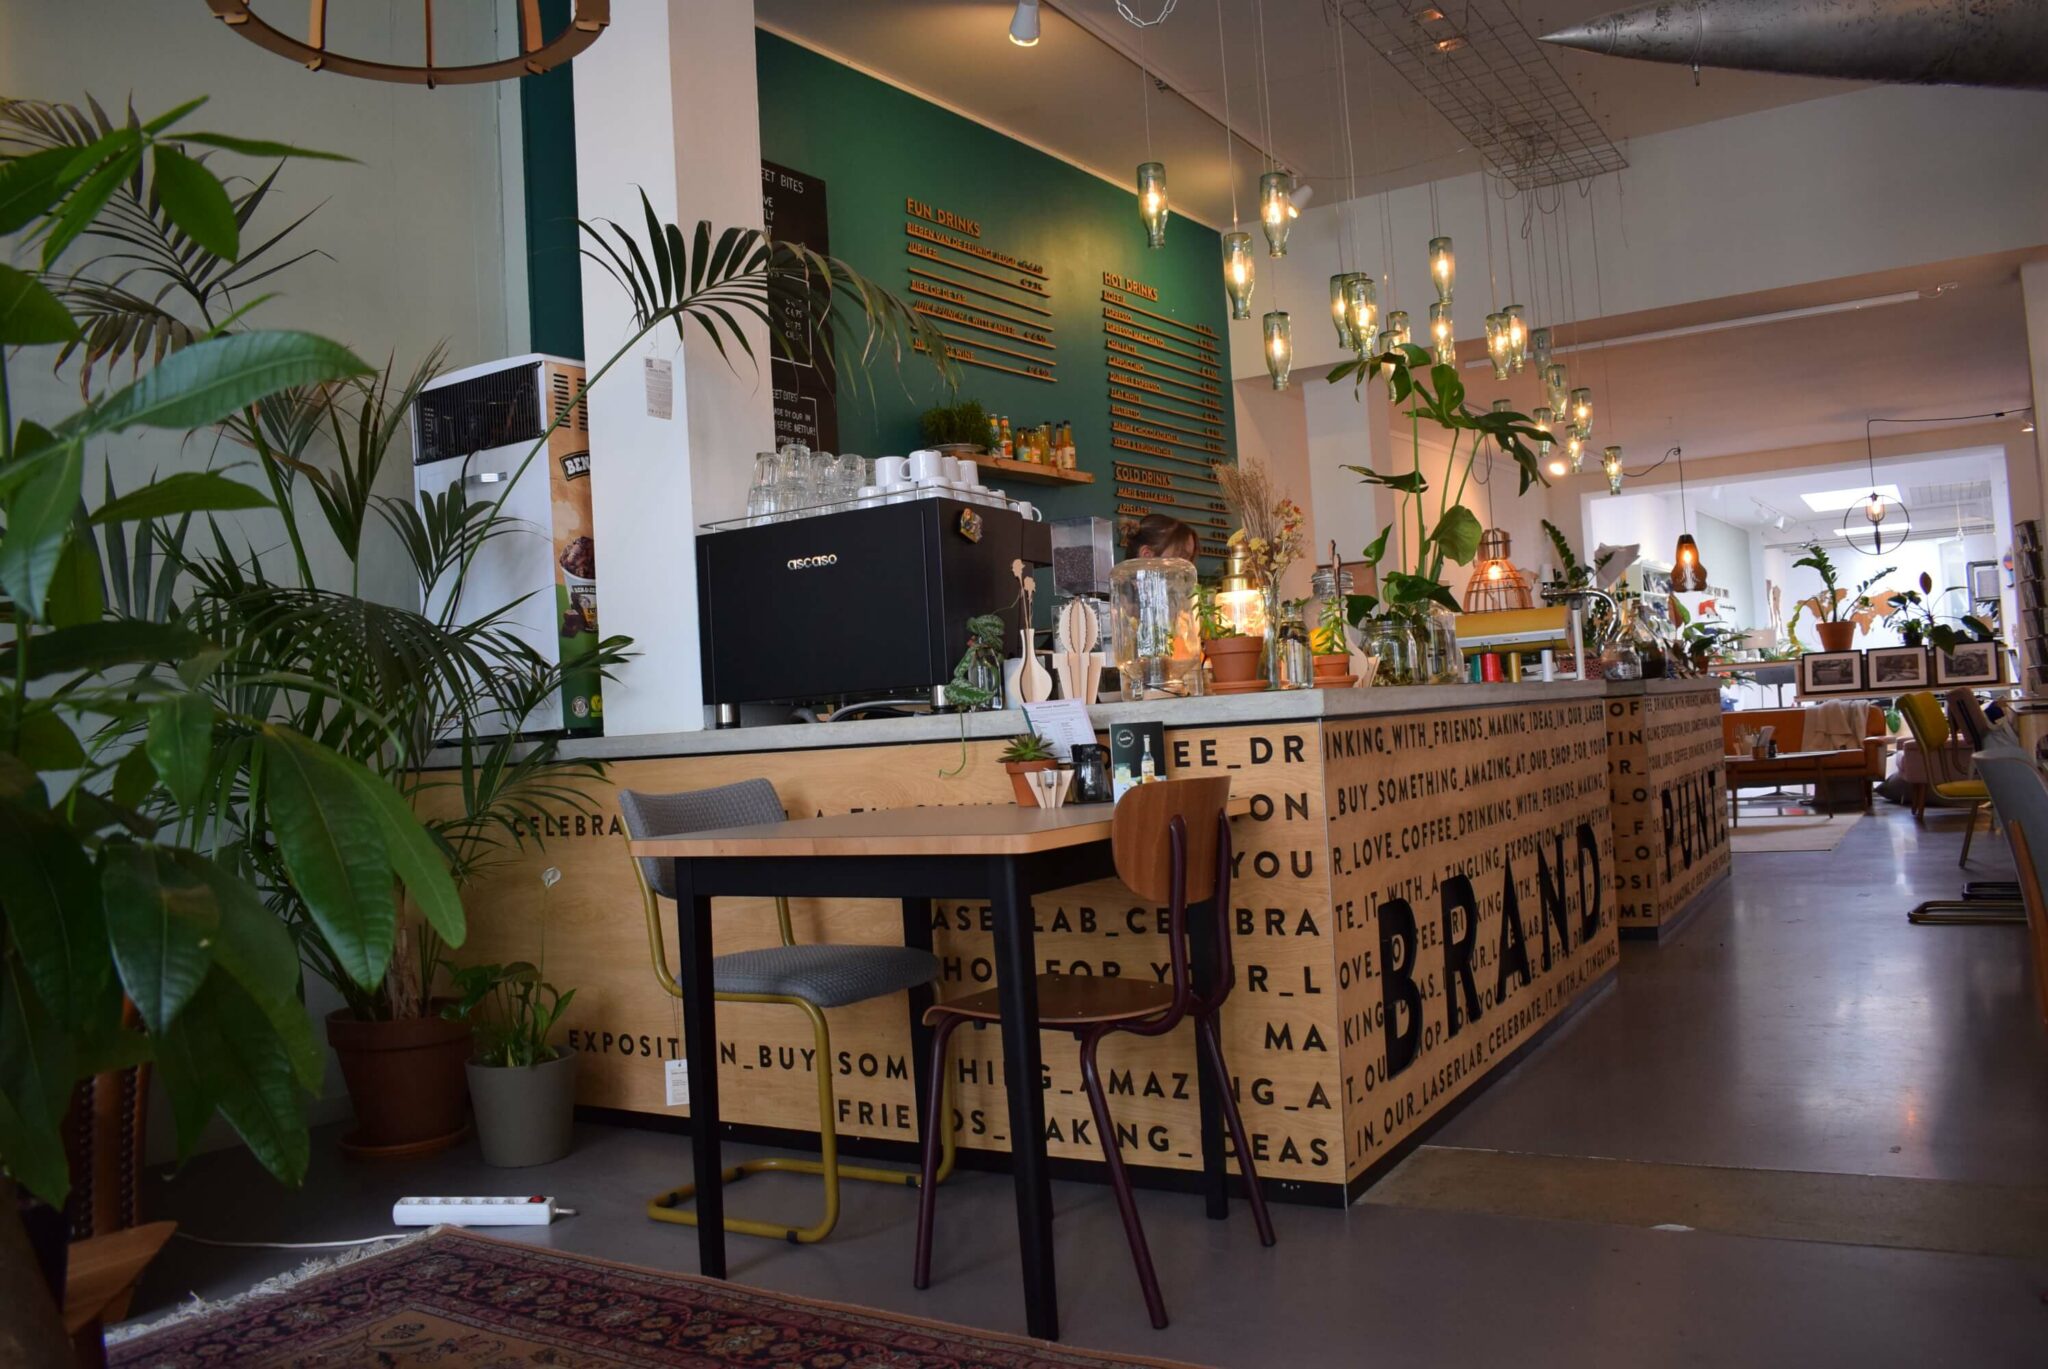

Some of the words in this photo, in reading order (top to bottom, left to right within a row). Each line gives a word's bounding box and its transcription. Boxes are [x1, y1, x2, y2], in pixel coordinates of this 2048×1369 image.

[780, 174, 804, 194] BITES
[907, 197, 932, 218] FUN
[937, 208, 981, 236] DRINKS
[1104, 272, 1121, 288] HOT
[1125, 279, 1158, 302] DRINKS
[1116, 466, 1140, 482] COLD
[1141, 471, 1171, 487] DRINKS
[787, 554, 837, 570] ascaso
[1609, 702, 1640, 716] OF
[1607, 729, 1643, 745] TIN
[1620, 903, 1653, 919] ME
[1378, 823, 1602, 1080] BRAND
[1264, 1021, 1327, 1052] MA
